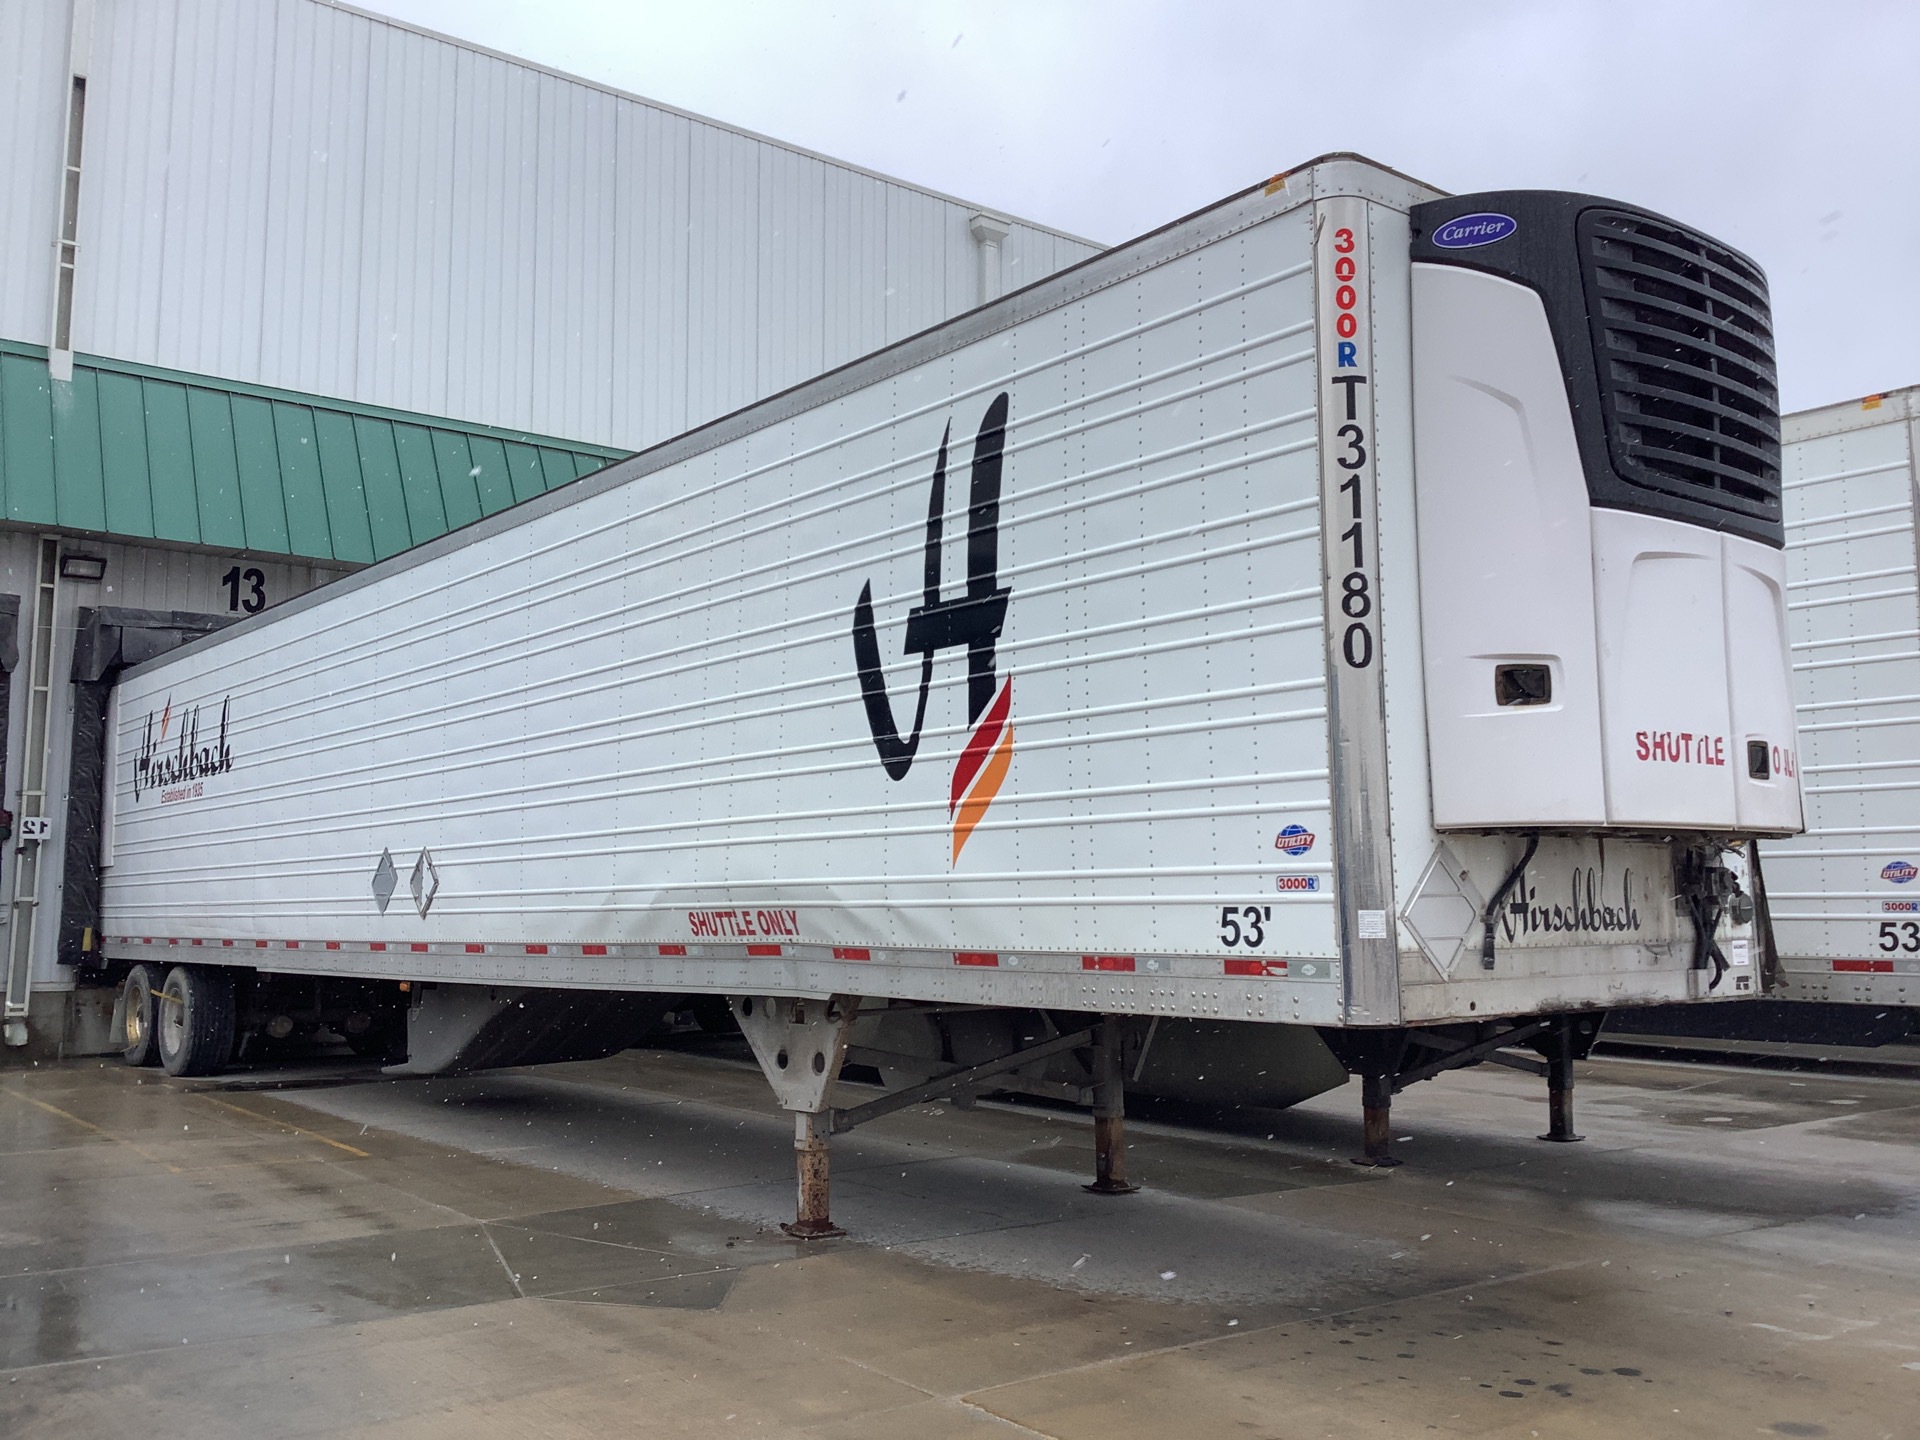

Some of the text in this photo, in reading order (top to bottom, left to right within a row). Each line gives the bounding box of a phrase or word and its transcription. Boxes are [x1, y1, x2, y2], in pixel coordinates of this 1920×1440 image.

[1442, 220, 1505, 242] Carrier
[1334, 228, 1358, 367] 3000R
[1331, 375, 1373, 669] T31180
[222, 566, 266, 613] 13
[134, 694, 234, 803] Hirschbach
[161, 785, 186, 803] Established
[1277, 834, 1315, 849] UTILITY
[1279, 877, 1315, 890] 3000R
[1882, 868, 1917, 879] UTILITY
[1500, 863, 1642, 943] Hirschbach
[1884, 902, 1918, 911] 3000R
[688, 909, 800, 937] SHUTTLE ONLY
[1220, 906, 1271, 947] 53'
[1879, 922, 1920, 953] 53
